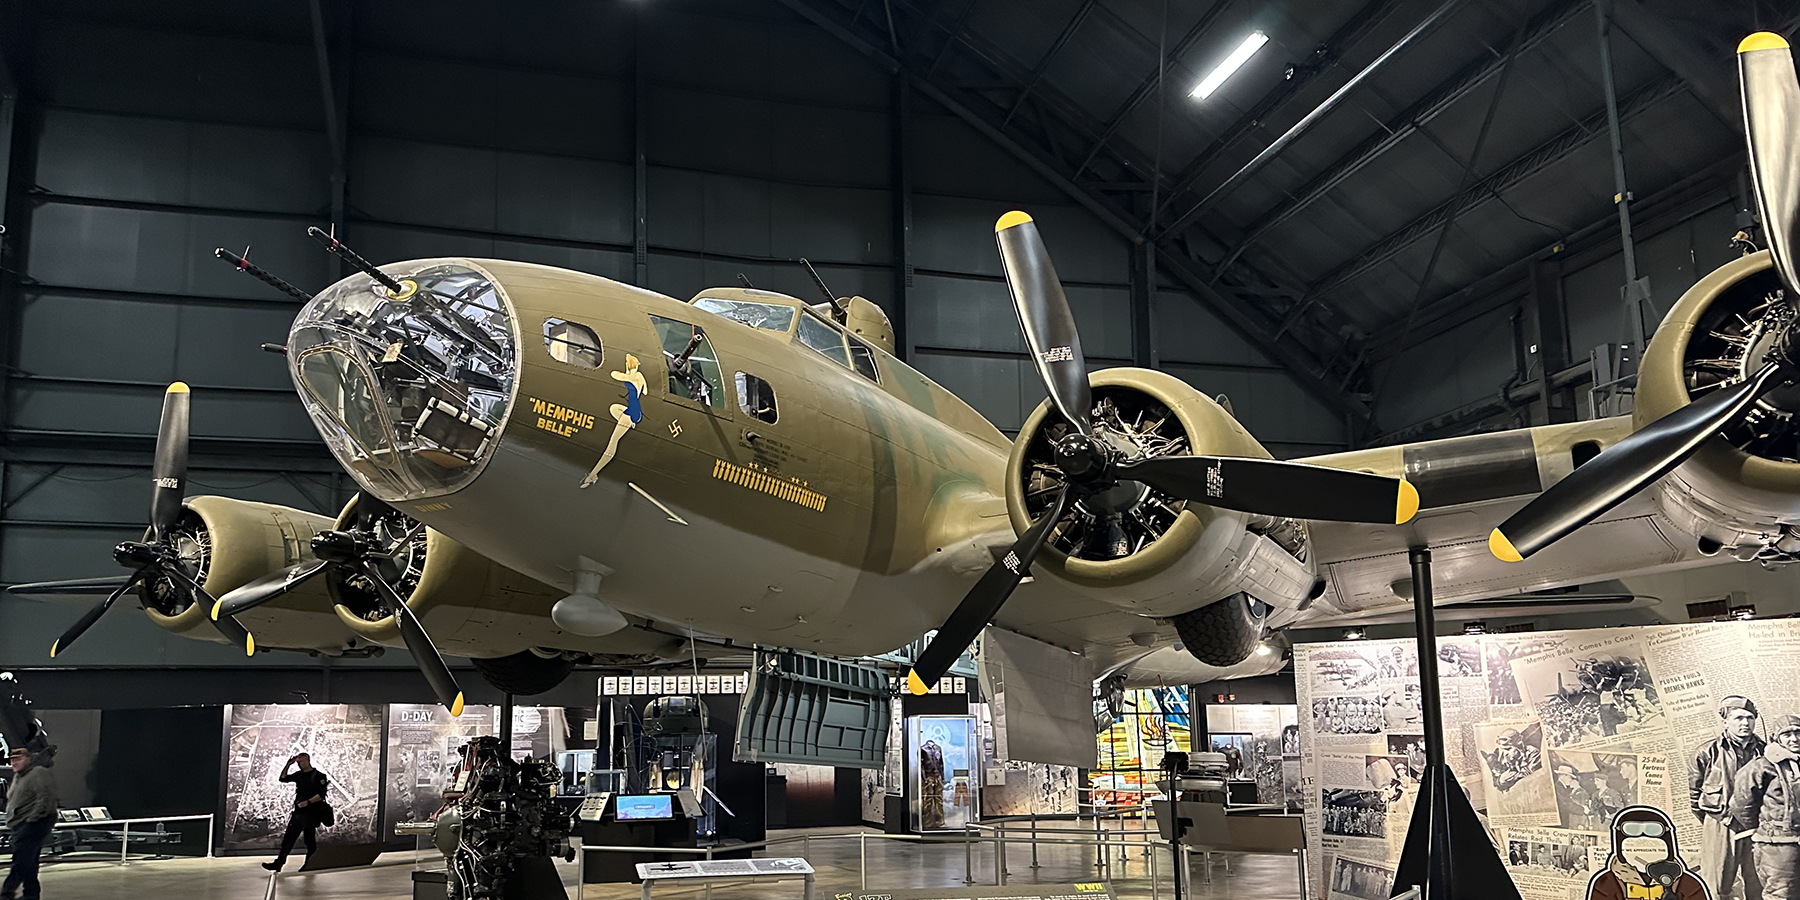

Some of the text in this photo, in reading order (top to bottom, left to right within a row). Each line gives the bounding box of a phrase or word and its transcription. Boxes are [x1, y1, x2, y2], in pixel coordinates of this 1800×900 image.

[529, 397, 595, 430] "MEMPHIS
[536, 417, 579, 437] BELLE"
[1748, 620, 1800, 630] Memphis Bell
[1748, 630, 1775, 639] Hailed
[1578, 642, 1601, 652] Comes
[1615, 633, 1635, 643] Coast
[1663, 678, 1705, 694] BREMEN HAWKS
[1641, 756, 1666, 764] 25-Raid
[1645, 771, 1663, 779] Comes
